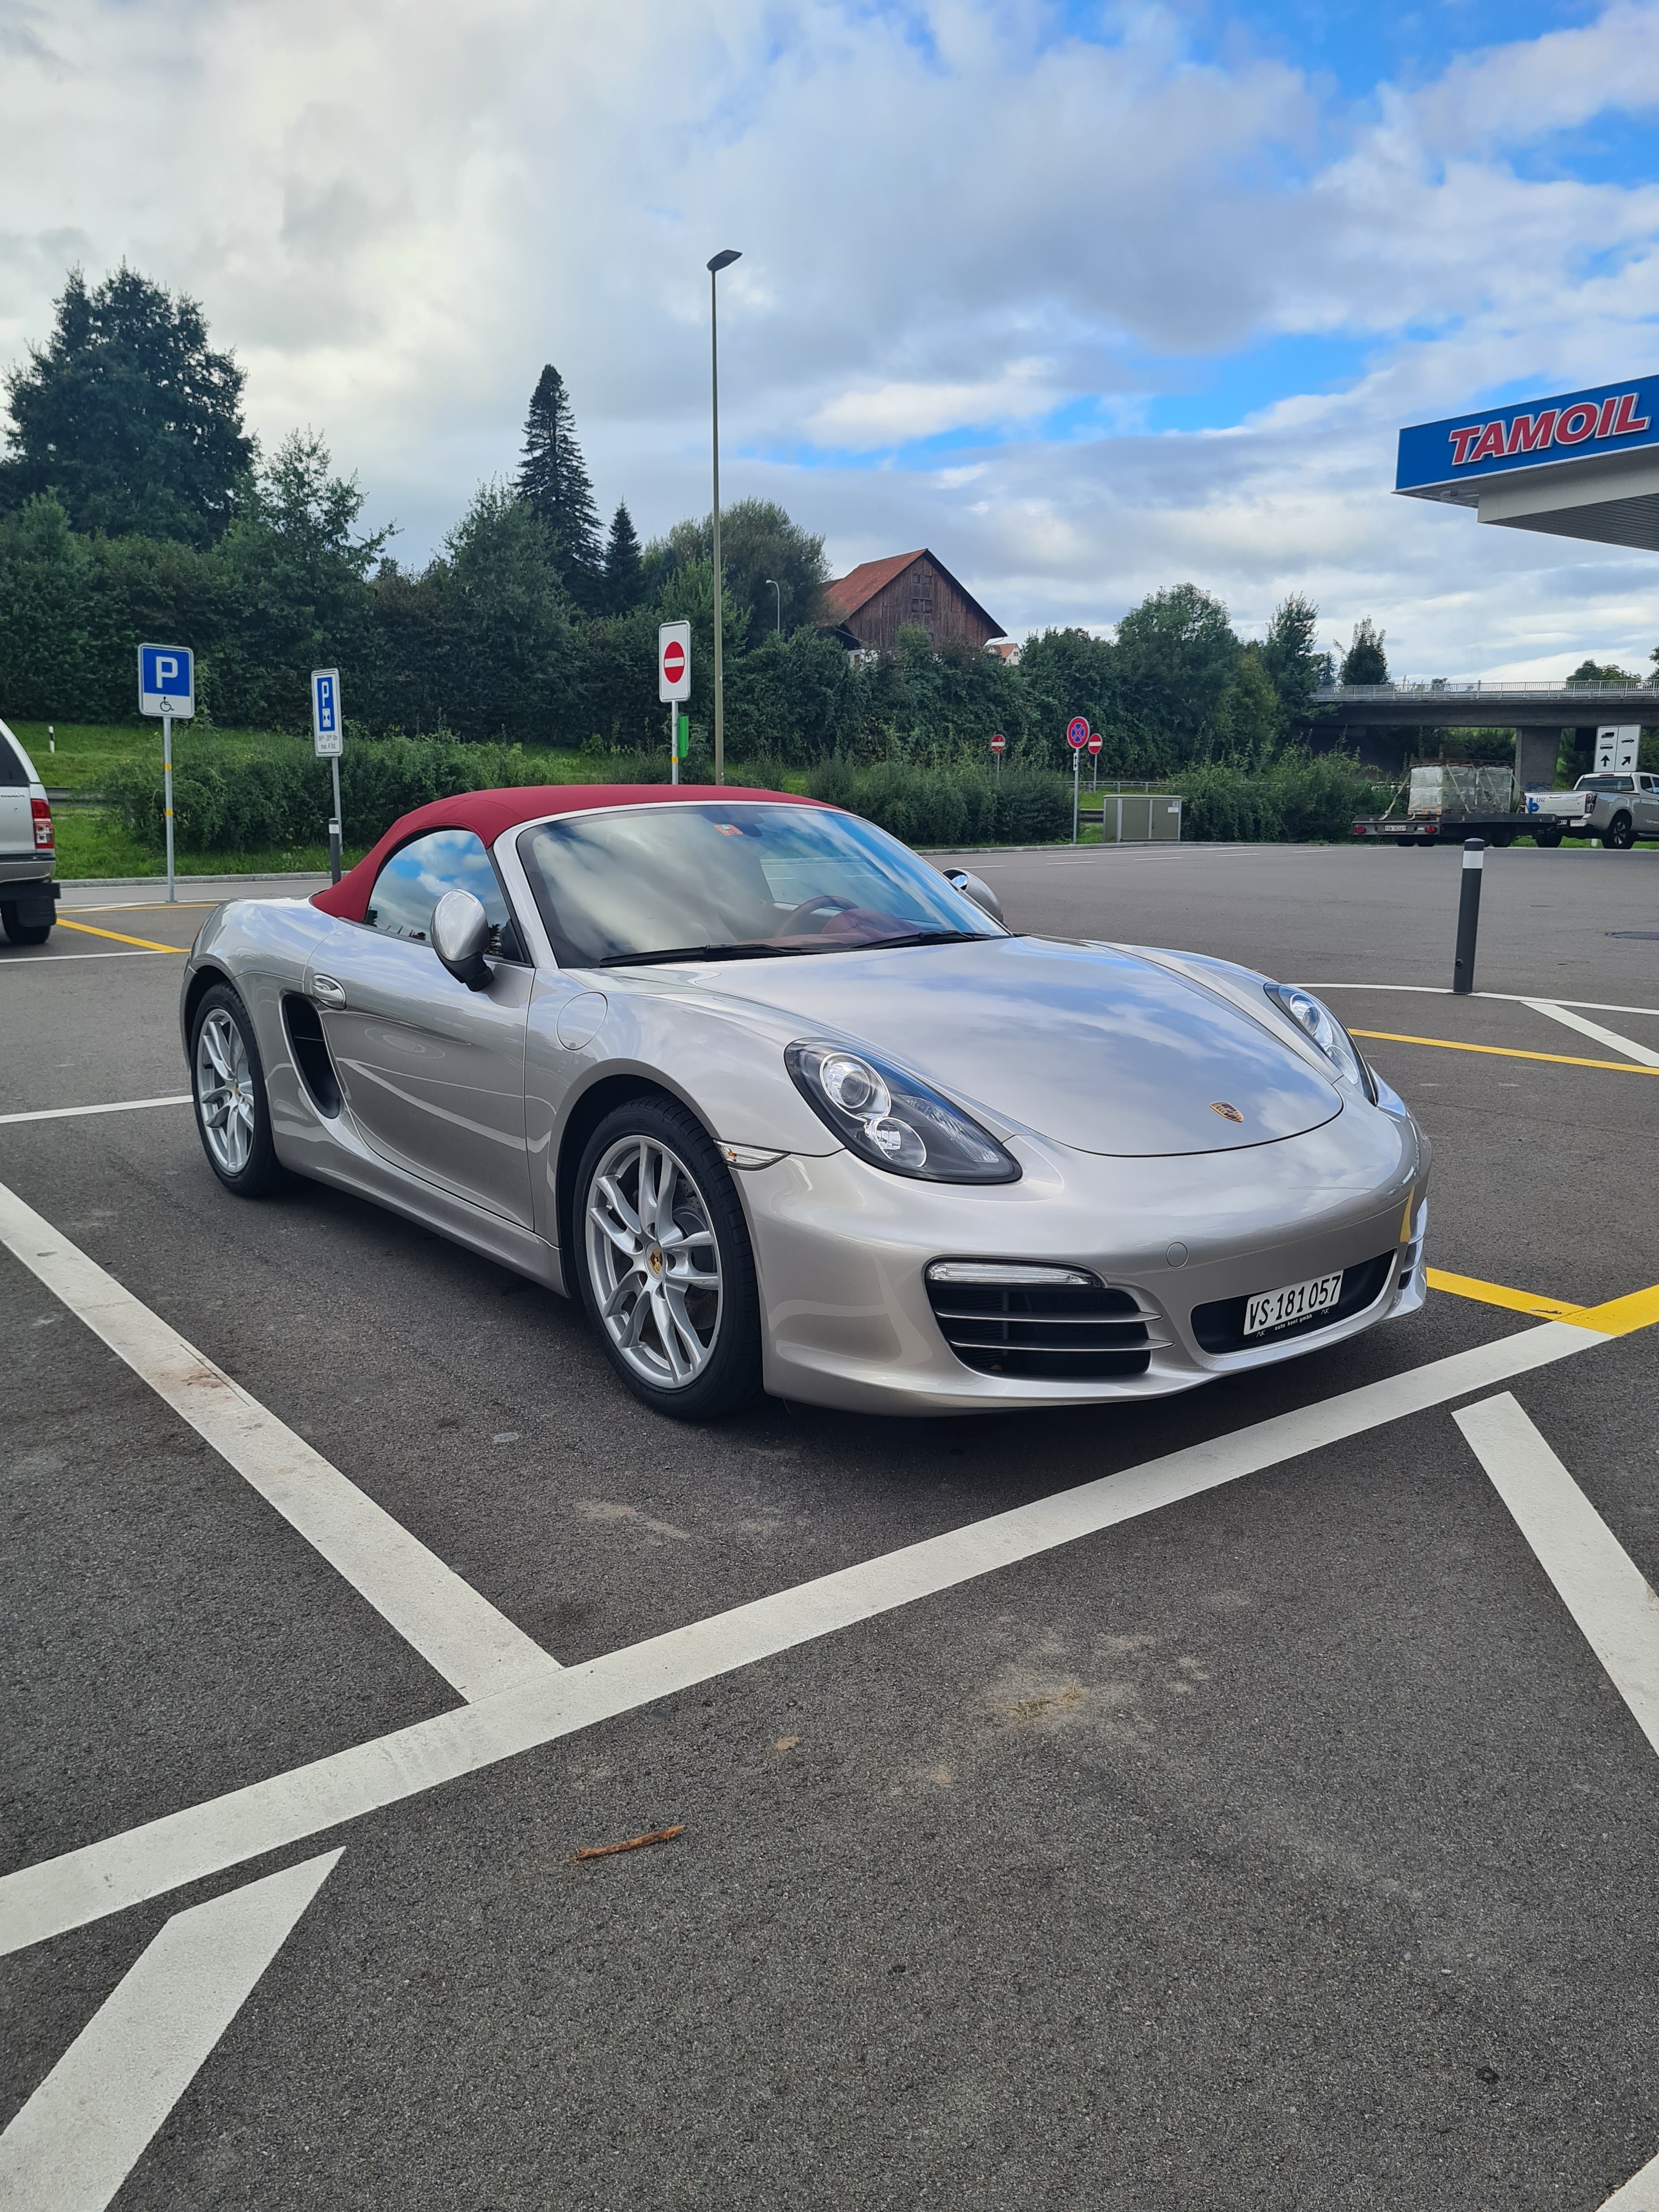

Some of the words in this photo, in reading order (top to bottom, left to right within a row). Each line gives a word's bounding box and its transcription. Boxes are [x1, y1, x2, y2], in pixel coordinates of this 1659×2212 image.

[1448, 392, 1651, 466] TAMOIL
[156, 656, 178, 689] P
[321, 681, 329, 707] P
[1300, 1314, 1312, 1323] gmbh
